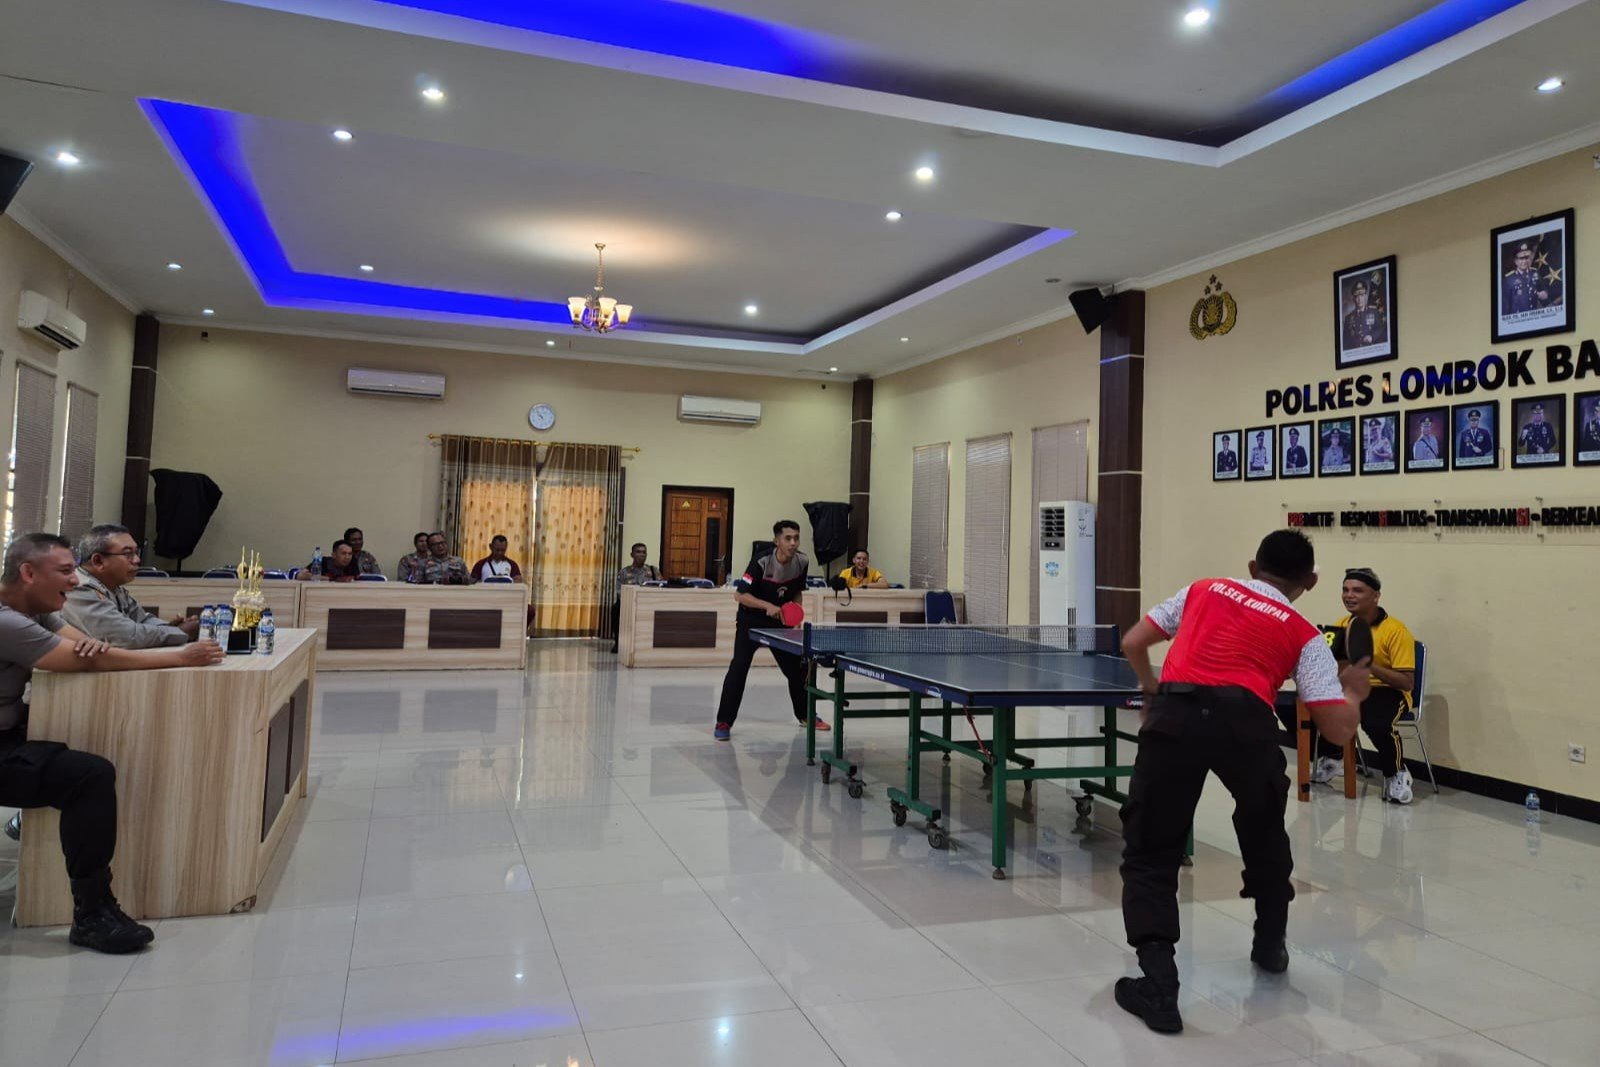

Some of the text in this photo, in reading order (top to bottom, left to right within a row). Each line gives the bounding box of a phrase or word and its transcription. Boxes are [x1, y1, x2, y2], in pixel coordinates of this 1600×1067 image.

[1266, 374, 1374, 418] POLRES
[1382, 348, 1536, 404] LOMBOK
[1541, 506, 1600, 526] BERKEA
[1208, 582, 1290, 622] POLSEK KURIPAN
